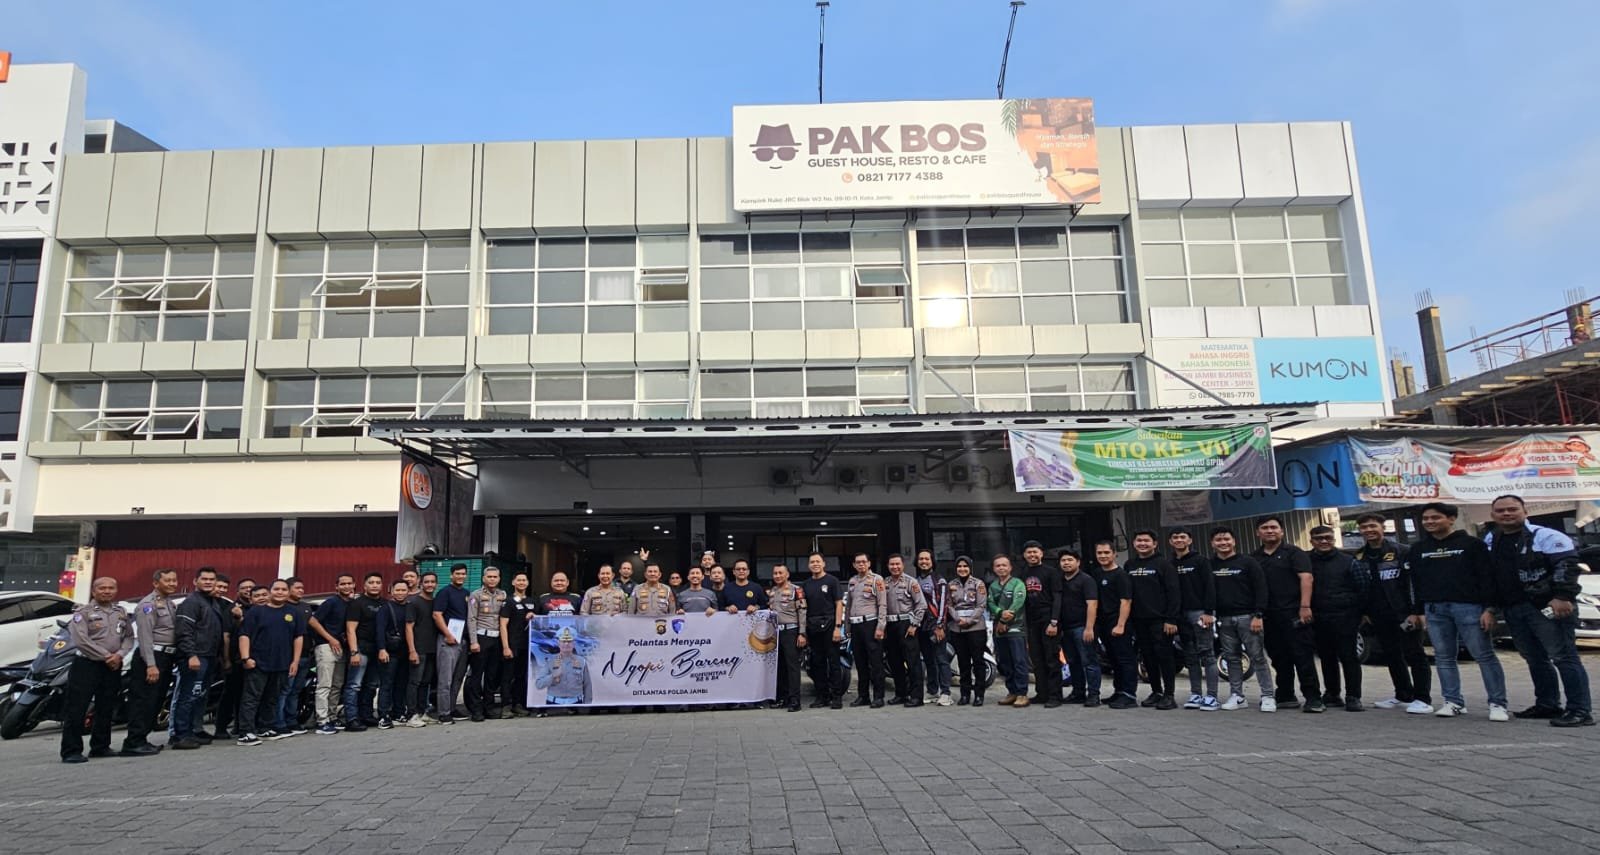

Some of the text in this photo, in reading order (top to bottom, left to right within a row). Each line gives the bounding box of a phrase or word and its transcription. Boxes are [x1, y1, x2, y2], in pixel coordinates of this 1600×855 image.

[808, 122, 987, 155] PAK BOS
[807, 154, 987, 168] GUEST HOUSE, RESTO & CAFE
[857, 171, 944, 182] 0821 7177 4388
[1164, 372, 1193, 380] KUON
[1270, 358, 1368, 380] KUMON
[1094, 441, 1148, 460] MTQ
[1153, 440, 1192, 458] KE-
[1371, 458, 1428, 476] Tahun
[1402, 472, 1438, 487] Baru
[1544, 481, 1577, 489] CENTER
[1371, 485, 1439, 498] 2025-2026
[628, 638, 712, 648] Polantas Menyapa
[601, 648, 742, 686] Ngopi Bareng
